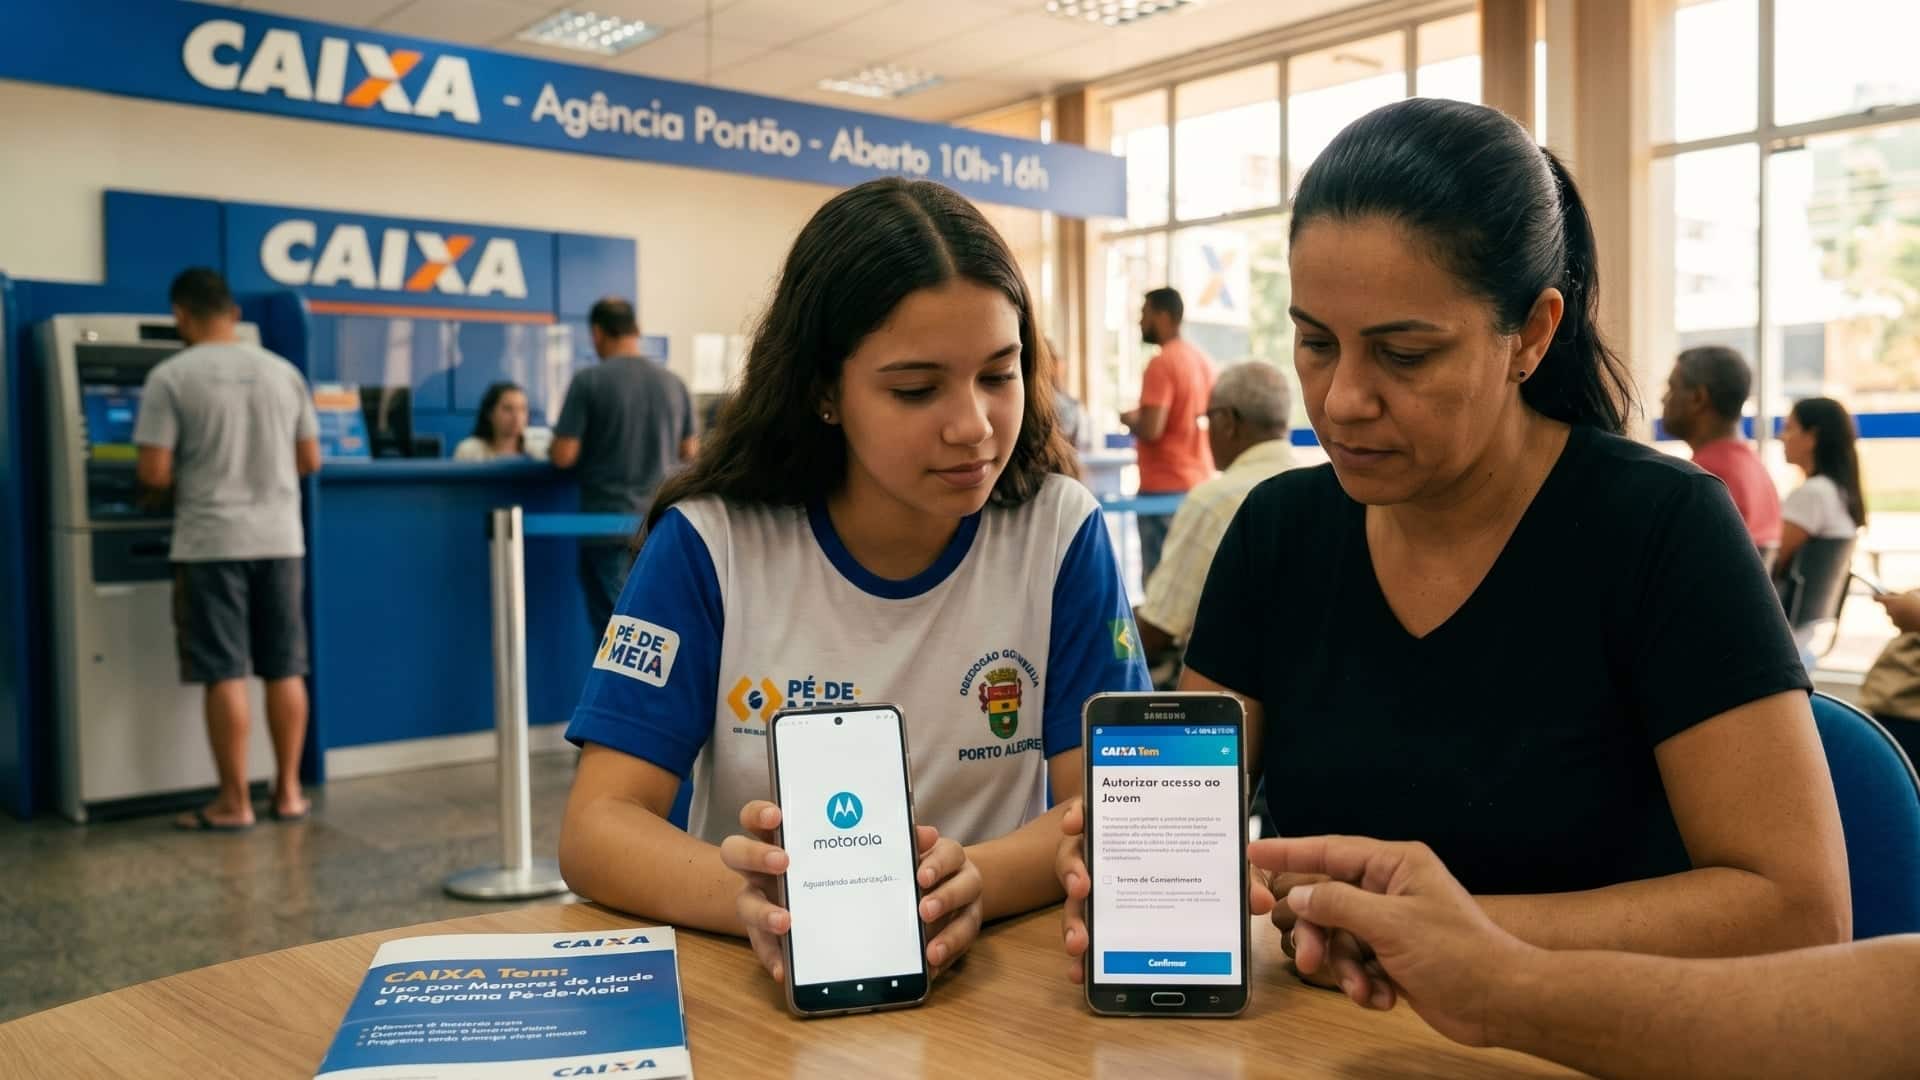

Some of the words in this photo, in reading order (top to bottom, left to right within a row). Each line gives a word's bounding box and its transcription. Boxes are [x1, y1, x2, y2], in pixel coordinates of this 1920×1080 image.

[182, 20, 481, 124] CAIXA
[531, 82, 685, 141] Agência
[694, 105, 801, 157] Portão
[828, 126, 930, 175] Aberto
[939, 142, 1049, 191] 10h-16h
[260, 219, 527, 298] CAIXA
[608, 642, 662, 678] MEIA
[959, 746, 1002, 760] PORTO
[1005, 738, 1042, 756] ALEGRE
[1101, 746, 1137, 756] CAIXA
[1138, 746, 1160, 756] Tem
[1102, 777, 1158, 788] Autorizar
[1161, 779, 1201, 788] acesso
[1204, 779, 1221, 788] ao
[1102, 793, 1141, 803] Jovem
[813, 832, 883, 850] motorola
[803, 877, 848, 890] Aguardando
[552, 935, 650, 949] CAIXA
[380, 985, 420, 995] Uso
[425, 984, 464, 994] por
[468, 980, 557, 991] Menores
[564, 977, 590, 987] de
[595, 972, 654, 984] Idade
[384, 968, 486, 983] CAIXA
[497, 967, 569, 979] Tem:
[374, 998, 388, 1006] e
[394, 992, 501, 1005] Programa
[552, 1058, 657, 1078] CAIXA
